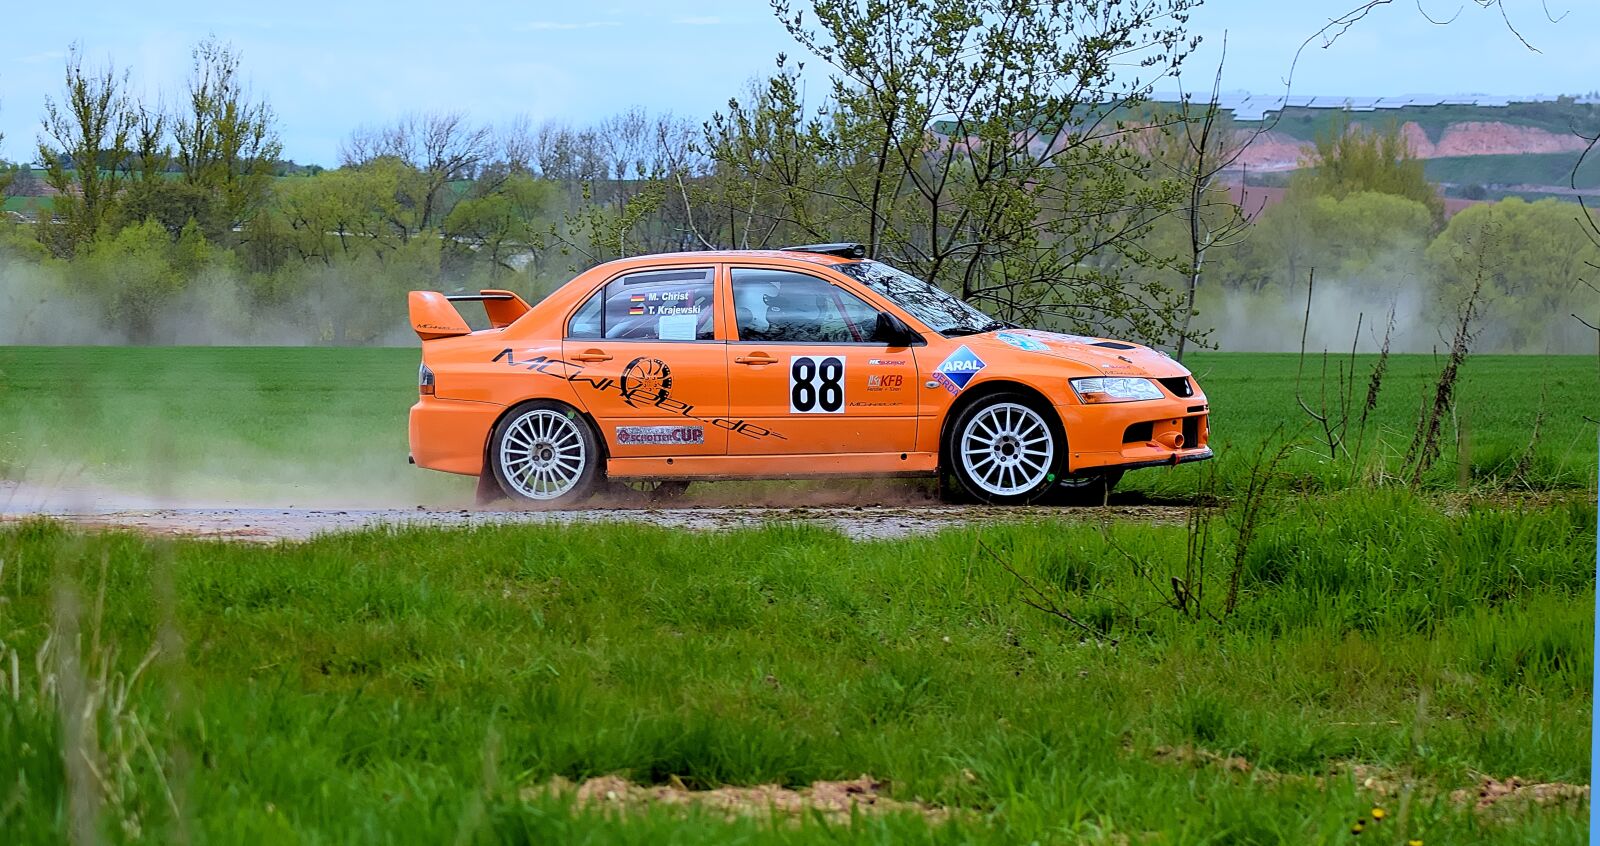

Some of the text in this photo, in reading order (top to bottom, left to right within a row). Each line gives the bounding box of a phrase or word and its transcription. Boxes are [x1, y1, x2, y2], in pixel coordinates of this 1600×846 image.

[662, 292, 689, 300] Christ
[648, 305, 701, 316] T. Krajewski
[943, 360, 981, 371] ARAL
[792, 357, 843, 412] 88
[880, 375, 903, 386] KFB
